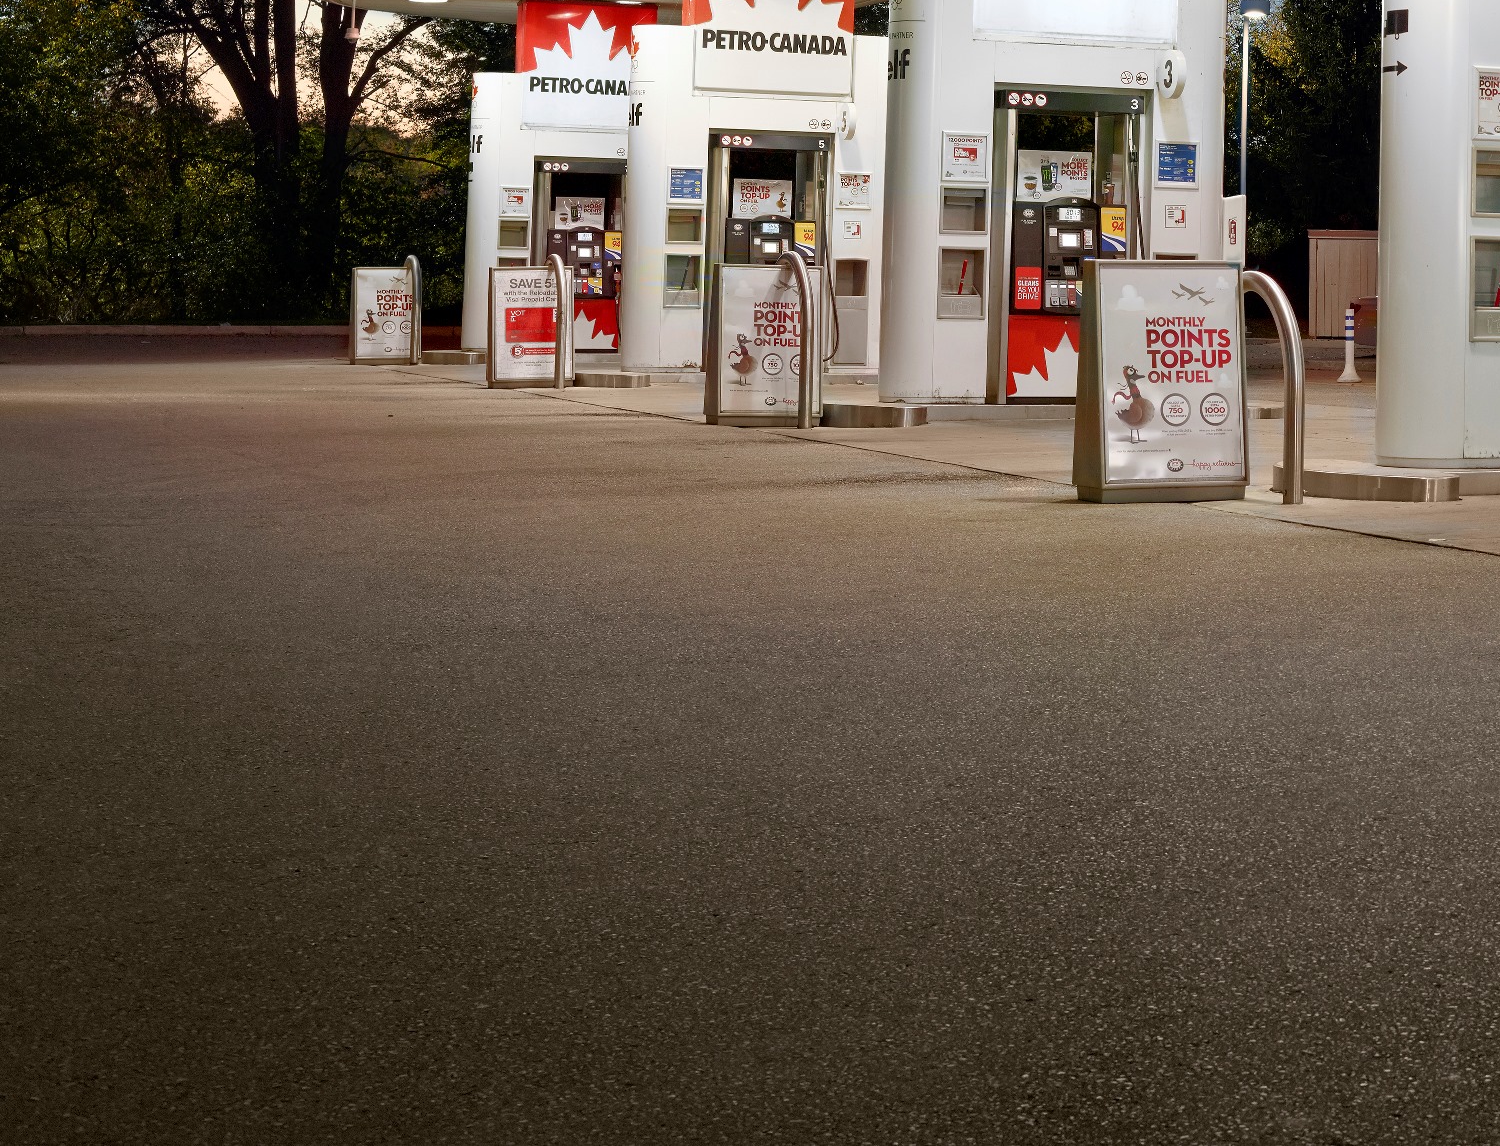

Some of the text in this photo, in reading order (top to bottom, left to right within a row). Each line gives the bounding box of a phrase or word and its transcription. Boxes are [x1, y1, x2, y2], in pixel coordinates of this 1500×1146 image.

[1163, 59, 1173, 89] 3
[529, 76, 630, 97] PETRO-CANA
[1130, 99, 1139, 110] 3
[841, 111, 847, 133] 5
[818, 140, 825, 149] 5
[1061, 162, 1088, 170] MORE
[1061, 169, 1088, 177] POINTS
[740, 185, 770, 193] POINTS
[740, 192, 770, 200] TOP-UP
[1111, 221, 1124, 232] 94
[803, 233, 813, 242] 94
[612, 240, 620, 248] 94
[509, 278, 541, 288] SAVE
[754, 301, 797, 310] MONTHLY
[753, 310, 800, 324] POINT
[1145, 317, 1206, 328] MONTHLY
[753, 323, 800, 337] TOP-U
[753, 337, 800, 347] ON FUEL
[1146, 329, 1231, 349] POINTS
[1146, 349, 1232, 369] TOP-UP
[1147, 370, 1213, 384] ON FUEL
[1192, 459, 1212, 471] happy
